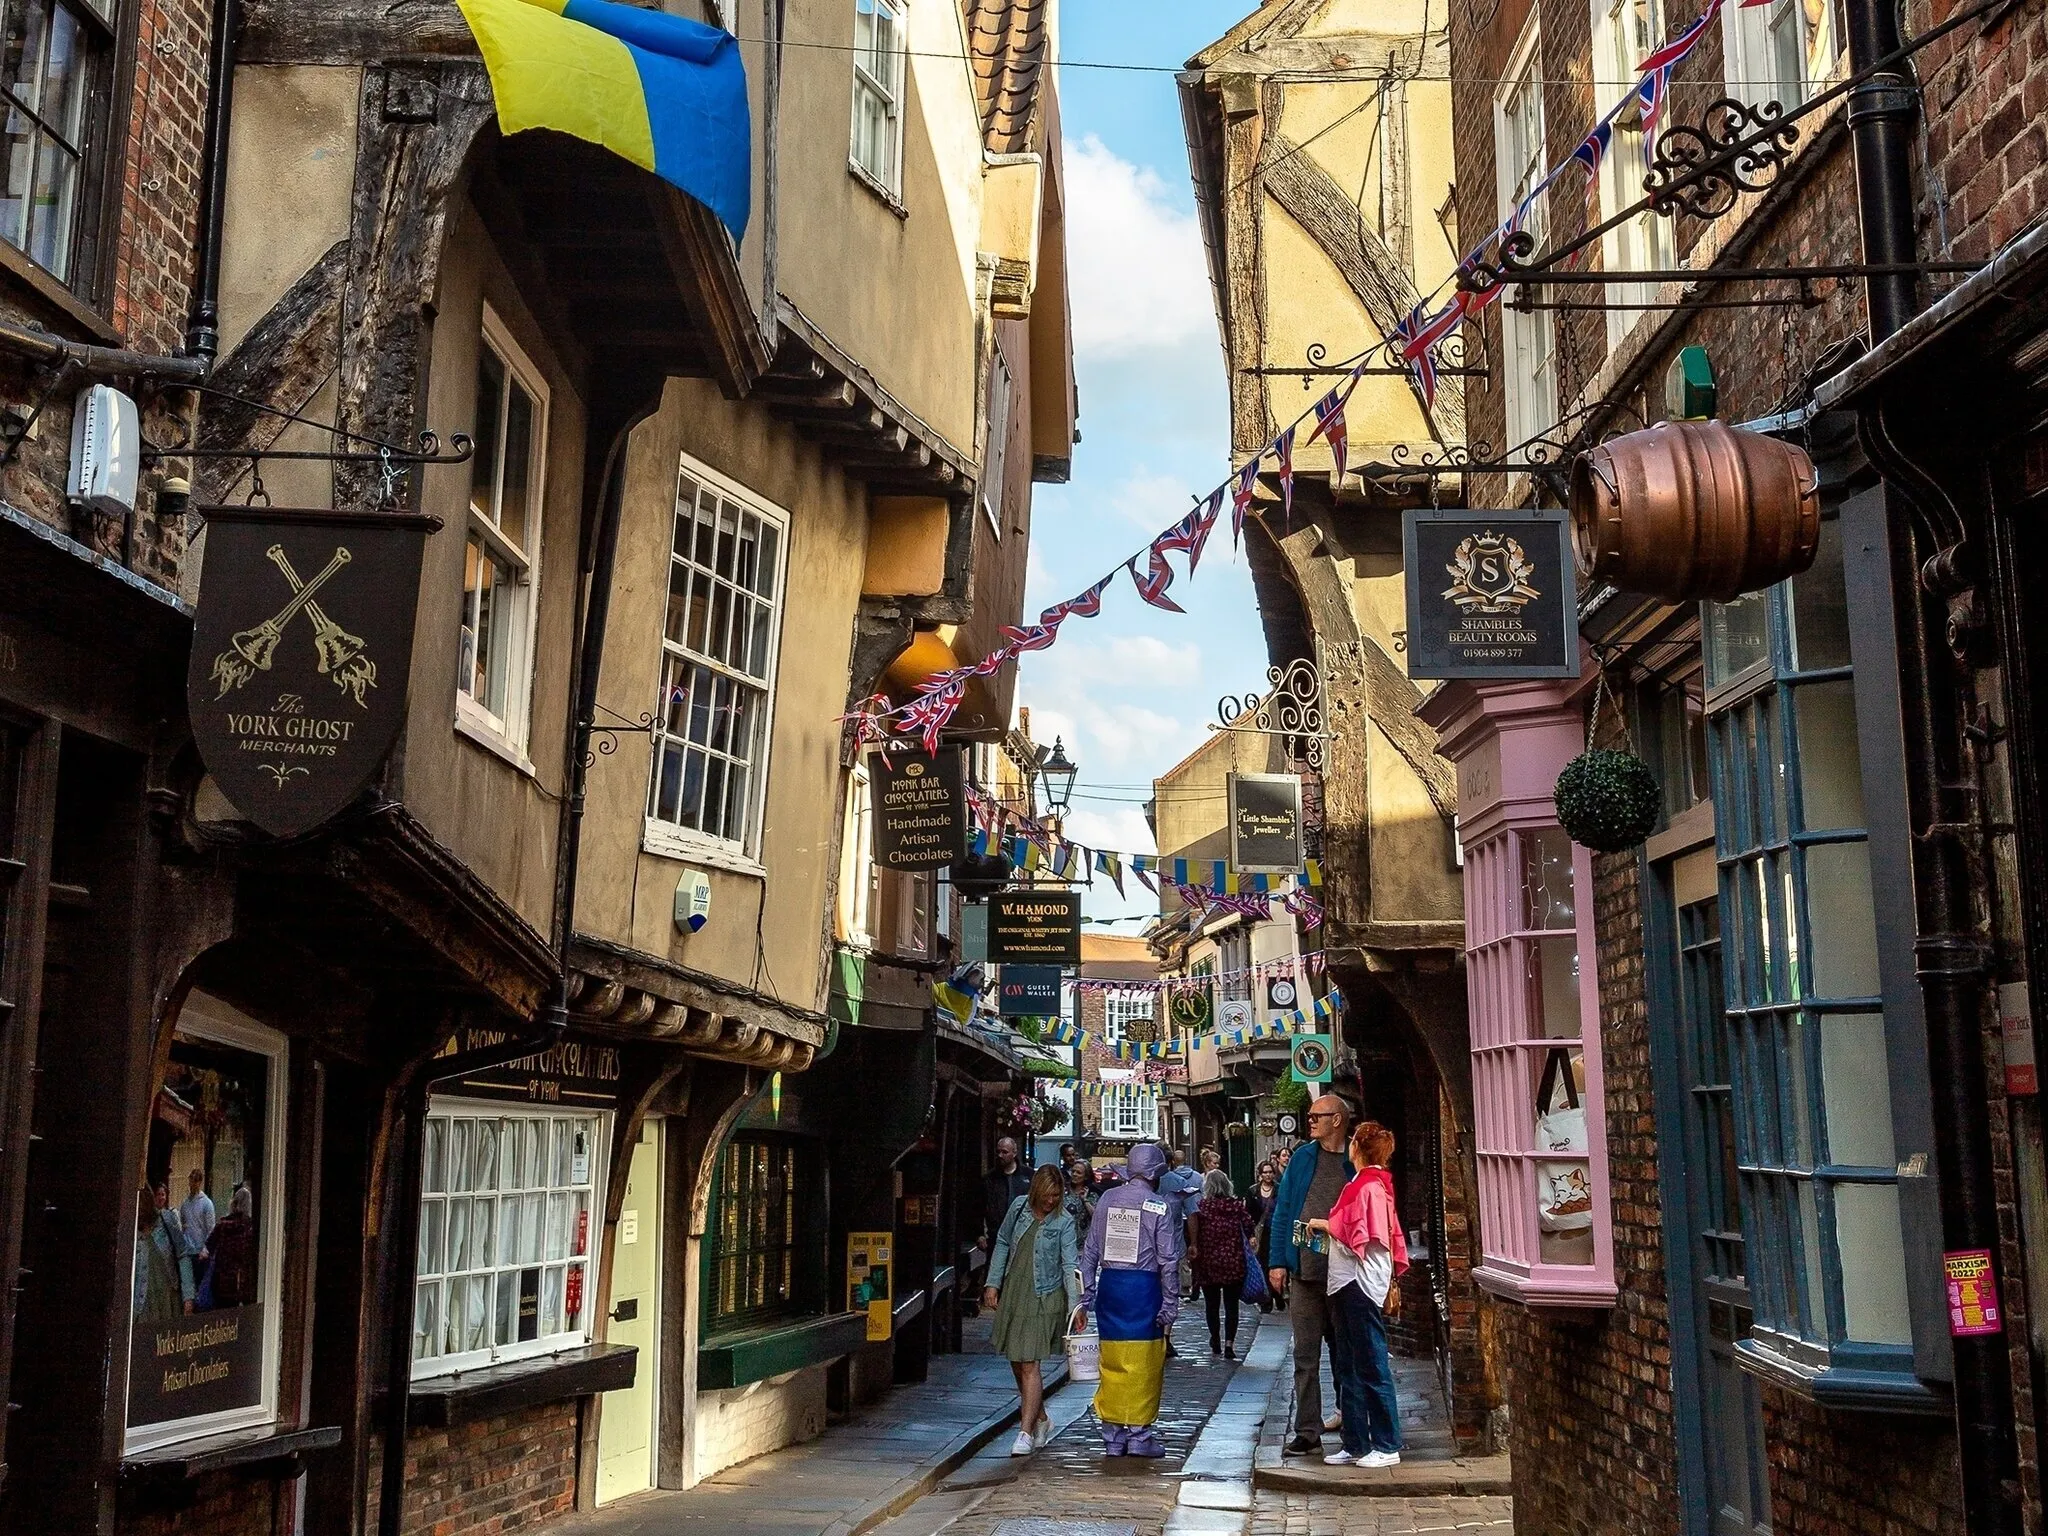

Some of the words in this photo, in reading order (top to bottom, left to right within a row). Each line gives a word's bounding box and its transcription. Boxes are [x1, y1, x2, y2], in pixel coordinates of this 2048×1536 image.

[1481, 557, 1499, 582] S
[1461, 620, 1522, 630] SHAMBLES
[1449, 632, 1495, 642] BEAUTY
[1496, 632, 1537, 642] ROOMS
[1463, 648, 1489, 658] 01904
[1490, 648, 1506, 658] 899
[1507, 648, 1523, 658] 377
[270, 693, 304, 713] The
[227, 713, 280, 736] YORK
[285, 718, 354, 741] GHOST
[239, 740, 337, 756] MERCHANTS
[891, 779, 919, 791] MONK
[921, 776, 940, 789] BAR
[884, 788, 950, 804] CHOCOLATIERS
[887, 813, 951, 830] Handmade
[1242, 814, 1260, 823] Little
[1260, 815, 1290, 824] Shambles
[1253, 826, 1281, 835] Jewellers
[900, 833, 940, 846] Artisan
[889, 848, 953, 863] Chocolates
[1001, 903, 1015, 916] W.
[1016, 904, 1069, 916] HAMOND
[1177, 998, 1202, 1018] N
[529, 1079, 539, 1099] OF
[541, 1081, 561, 1100] YORK
[1108, 1213, 1139, 1223] UKRAINE
[1946, 1258, 1988, 1271] MARXISM
[1952, 1269, 1976, 1278] 2022
[161, 1367, 188, 1393] Artisan
